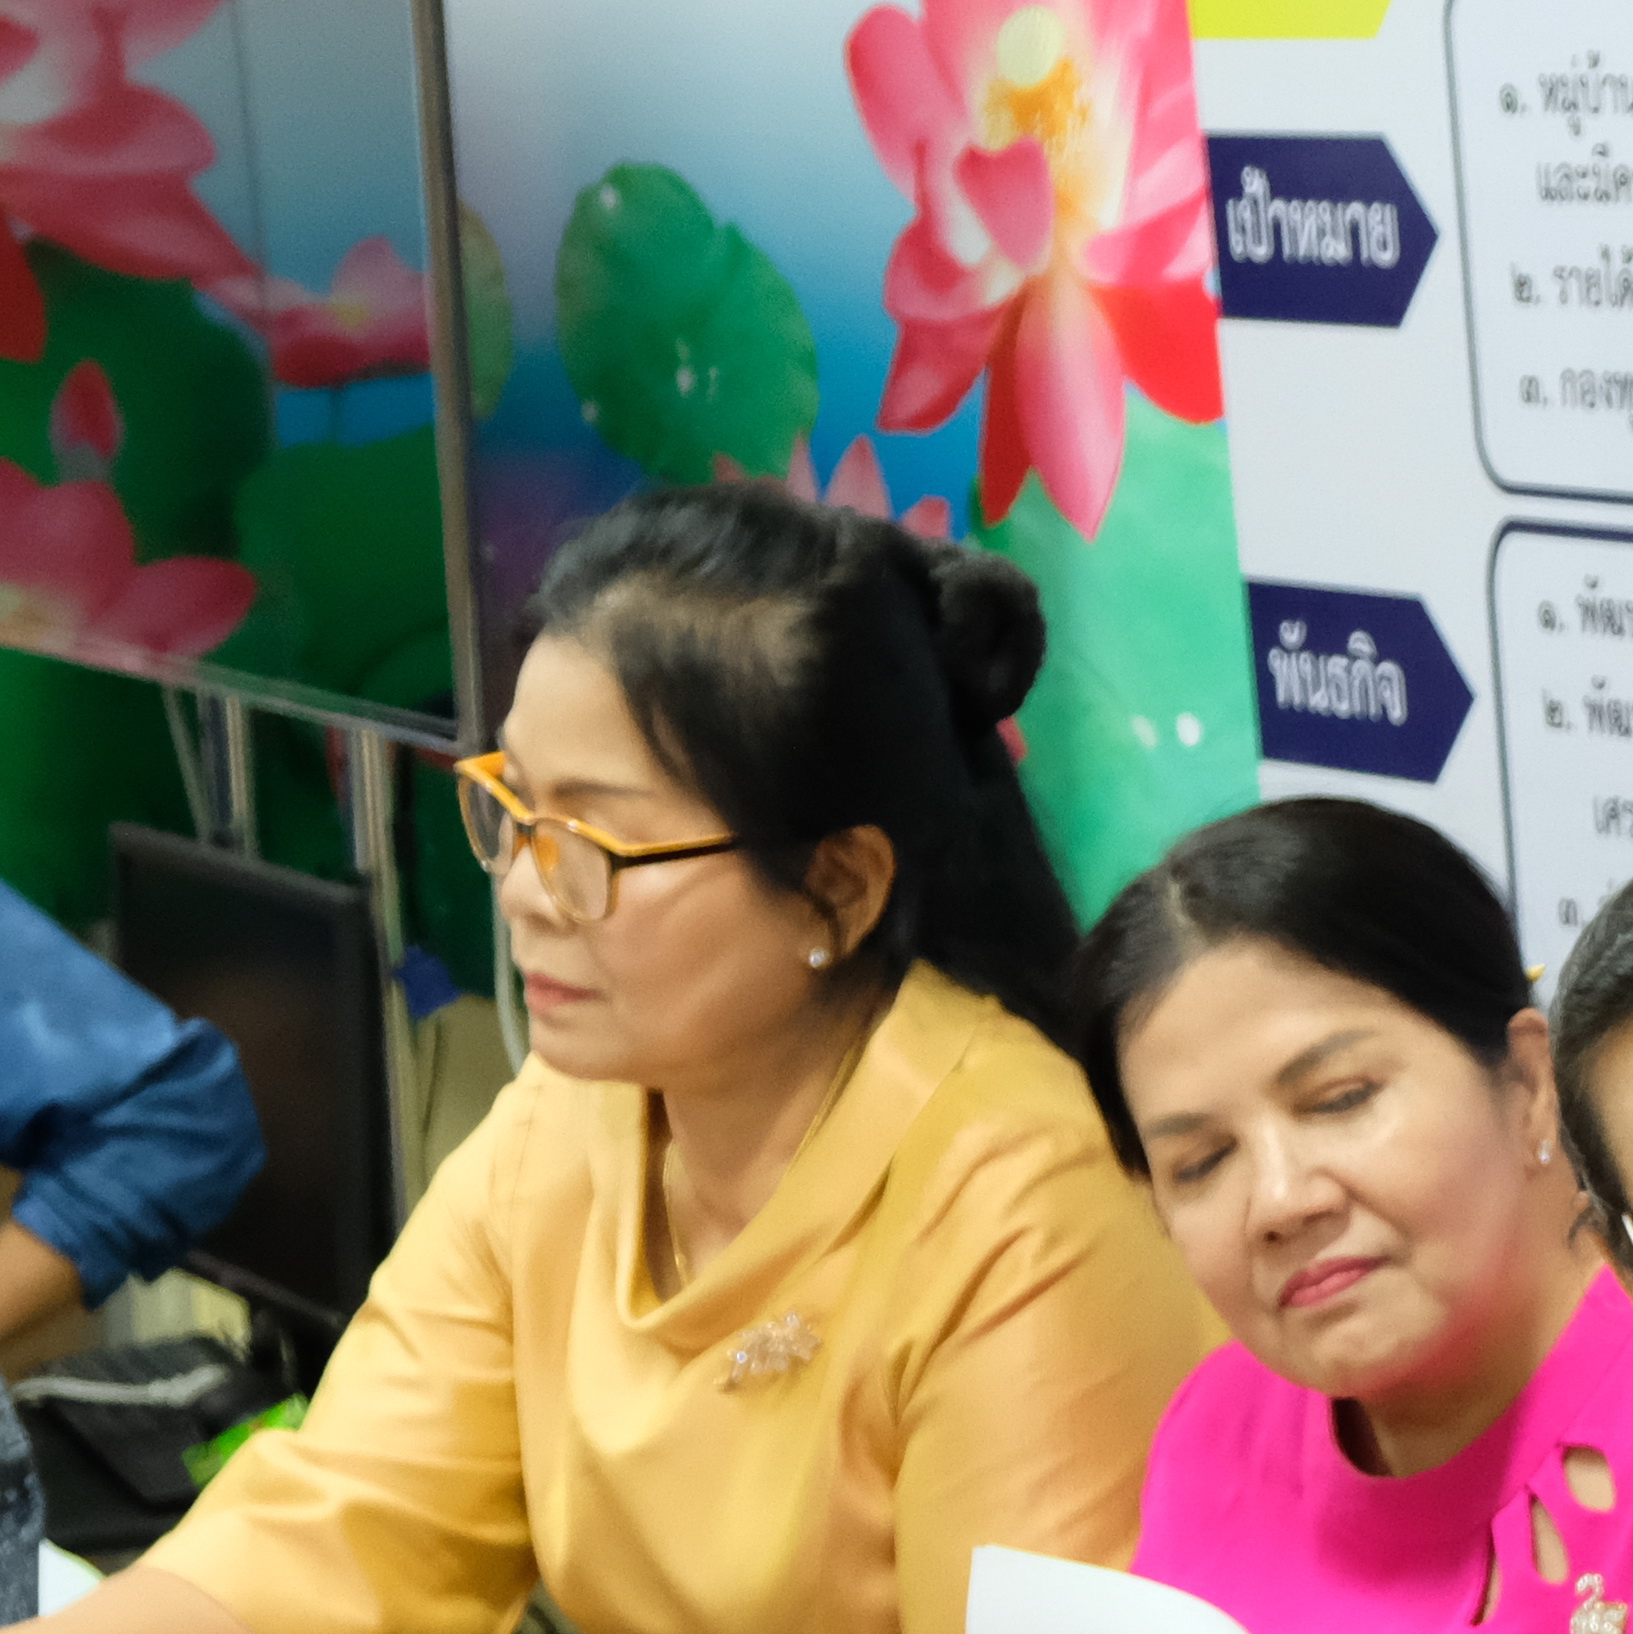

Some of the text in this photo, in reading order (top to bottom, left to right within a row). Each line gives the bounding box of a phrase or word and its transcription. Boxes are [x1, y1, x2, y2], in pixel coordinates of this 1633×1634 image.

[1226, 165, 1400, 269] เป้าหมาย
[1267, 620, 1407, 727] พันธกิจ
